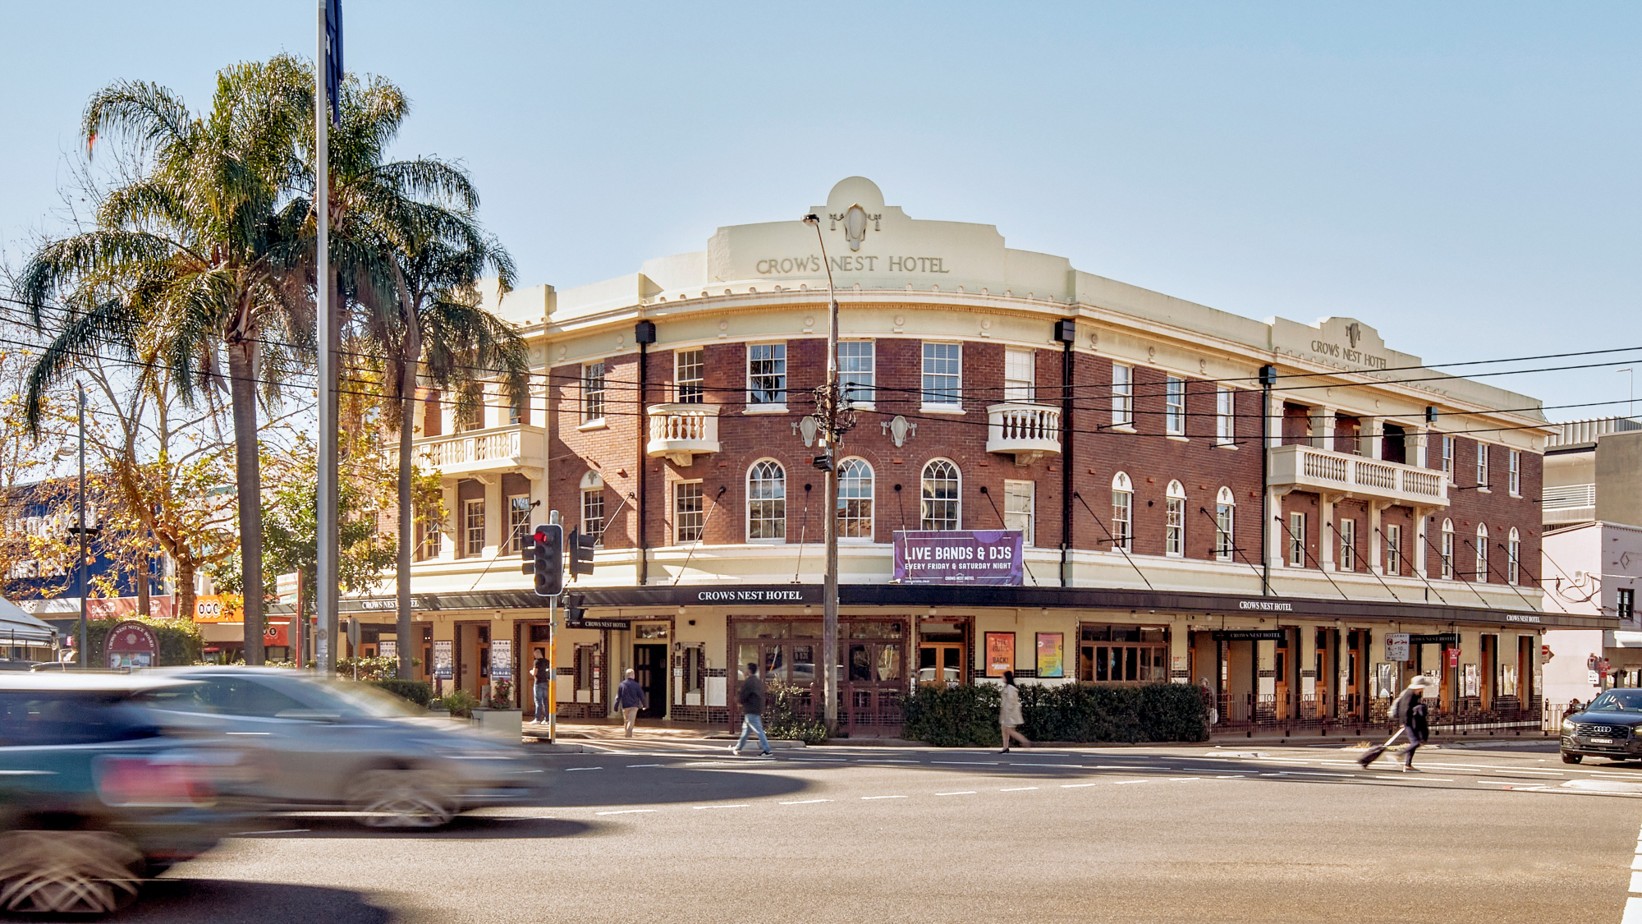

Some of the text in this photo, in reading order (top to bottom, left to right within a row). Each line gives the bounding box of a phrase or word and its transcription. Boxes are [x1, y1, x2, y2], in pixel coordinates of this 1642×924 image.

[756, 254, 950, 274] CROW'S NEST HOTEL
[1311, 339, 1388, 370] CROW'S NEST HOTEL
[904, 546, 1012, 560] LIVE BANDS & DJS
[958, 562, 991, 570] SATURDAY
[698, 590, 803, 601] CROWS NEST HOTEL
[1239, 600, 1293, 611] CROWS NEST HOTEL
